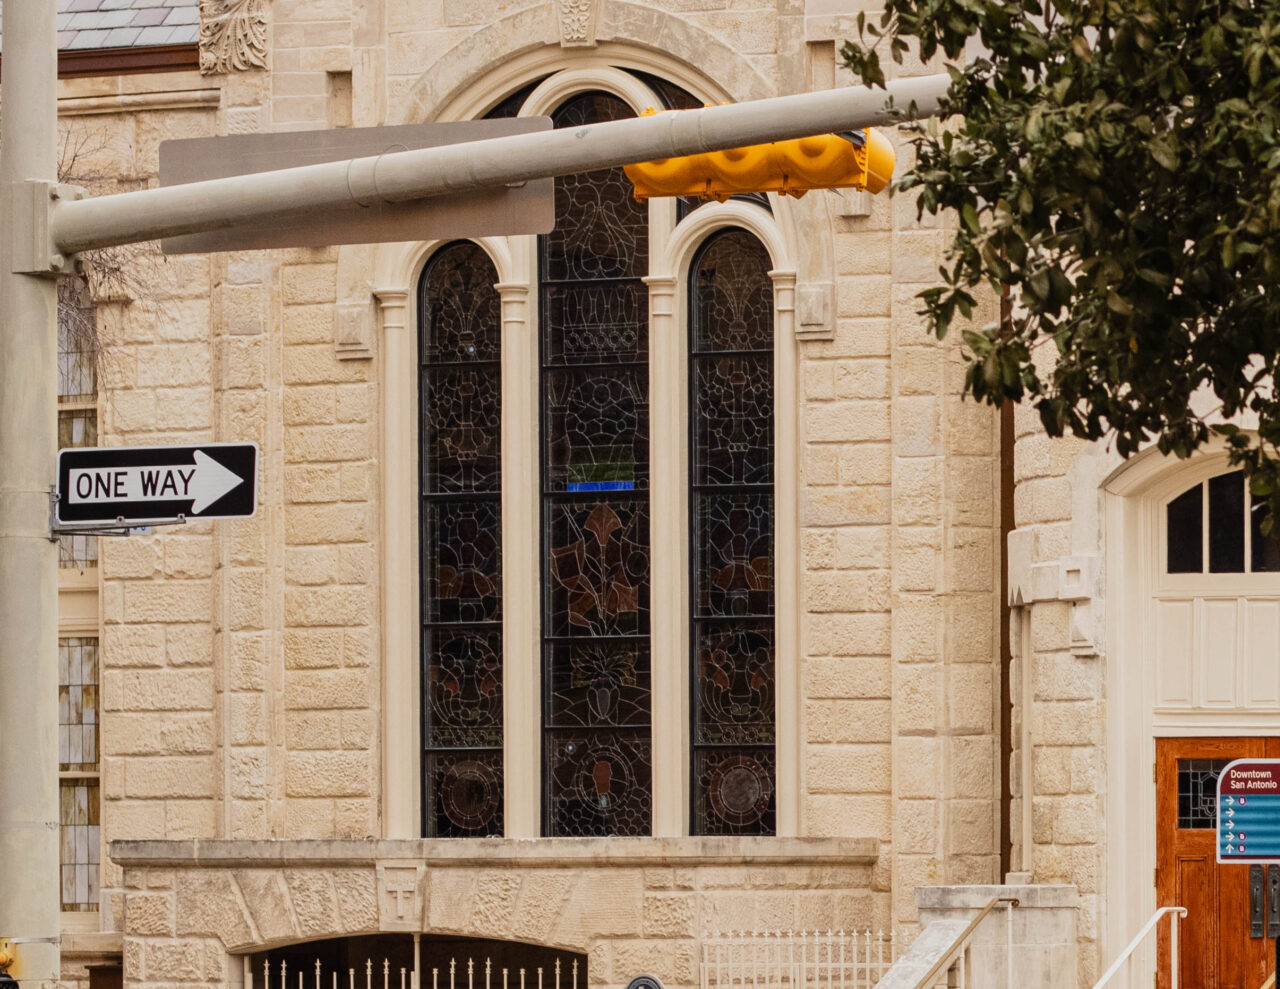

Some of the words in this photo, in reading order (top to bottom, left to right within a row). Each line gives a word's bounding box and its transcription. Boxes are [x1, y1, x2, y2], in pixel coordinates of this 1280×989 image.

[76, 471, 128, 499] ONE
[140, 469, 195, 497] WAY
[1230, 769, 1272, 779] Downtown
[1230, 780, 1245, 789] San
[1247, 780, 1278, 789] Antonio
